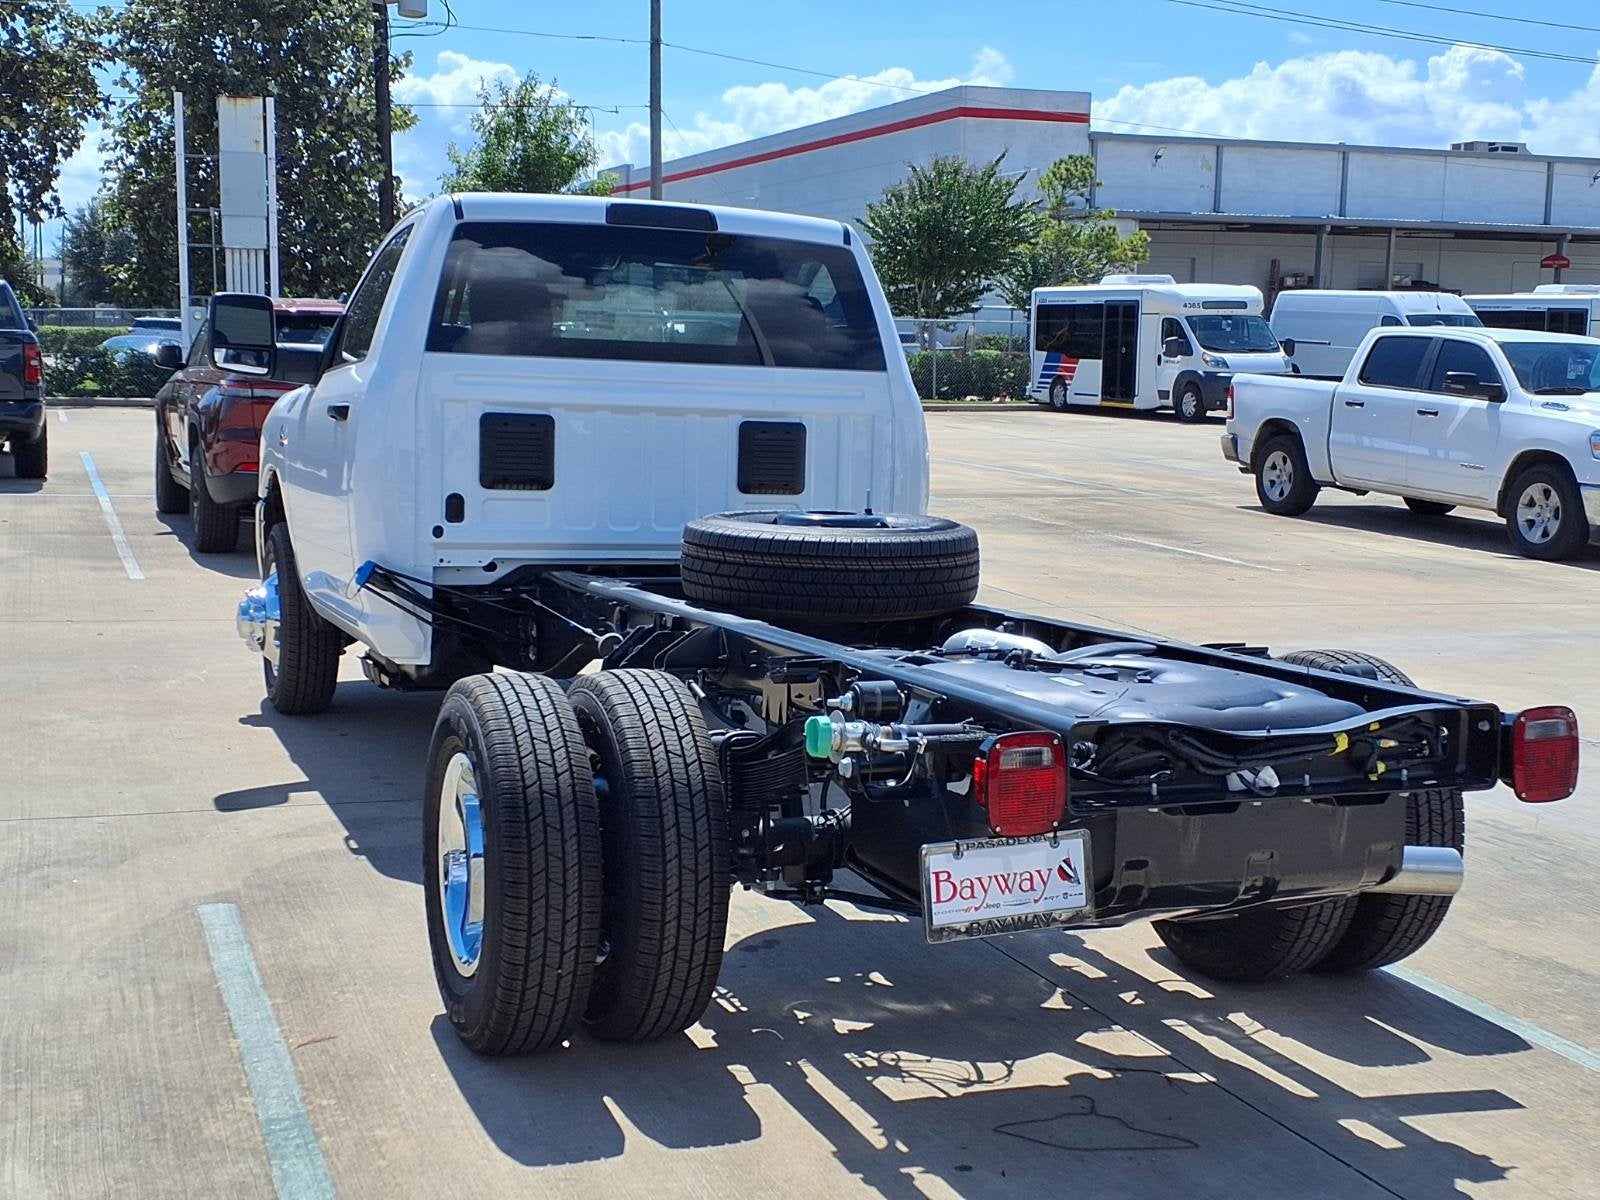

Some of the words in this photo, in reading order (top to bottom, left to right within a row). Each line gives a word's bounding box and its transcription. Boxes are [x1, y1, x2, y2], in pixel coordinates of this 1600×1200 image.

[964, 836, 1048, 851] PASADENA
[932, 868, 1053, 912] Bayway
[969, 912, 1055, 937] BAYWAY
